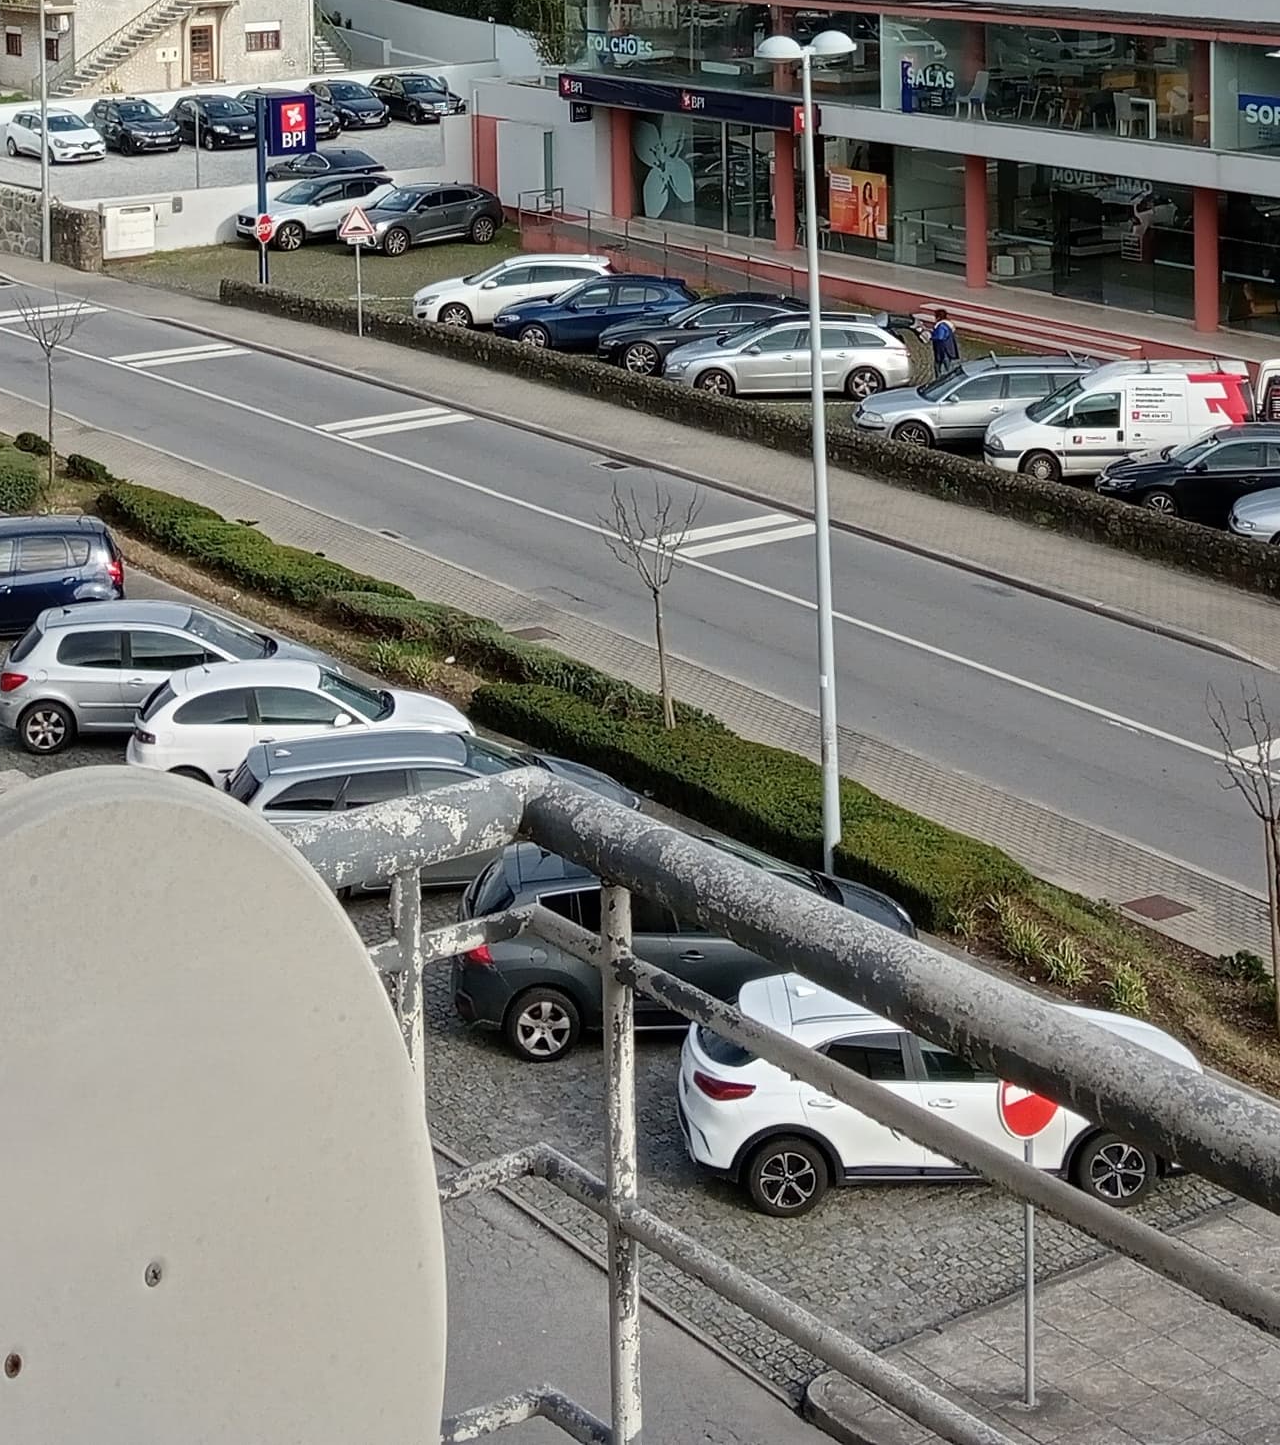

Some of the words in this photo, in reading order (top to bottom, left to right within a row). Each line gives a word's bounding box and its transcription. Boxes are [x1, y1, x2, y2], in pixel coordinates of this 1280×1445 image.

[907, 66, 955, 89] SALAS
[570, 80, 583, 94] BPI
[691, 95, 705, 109] BPI
[282, 131, 306, 148] BPI
